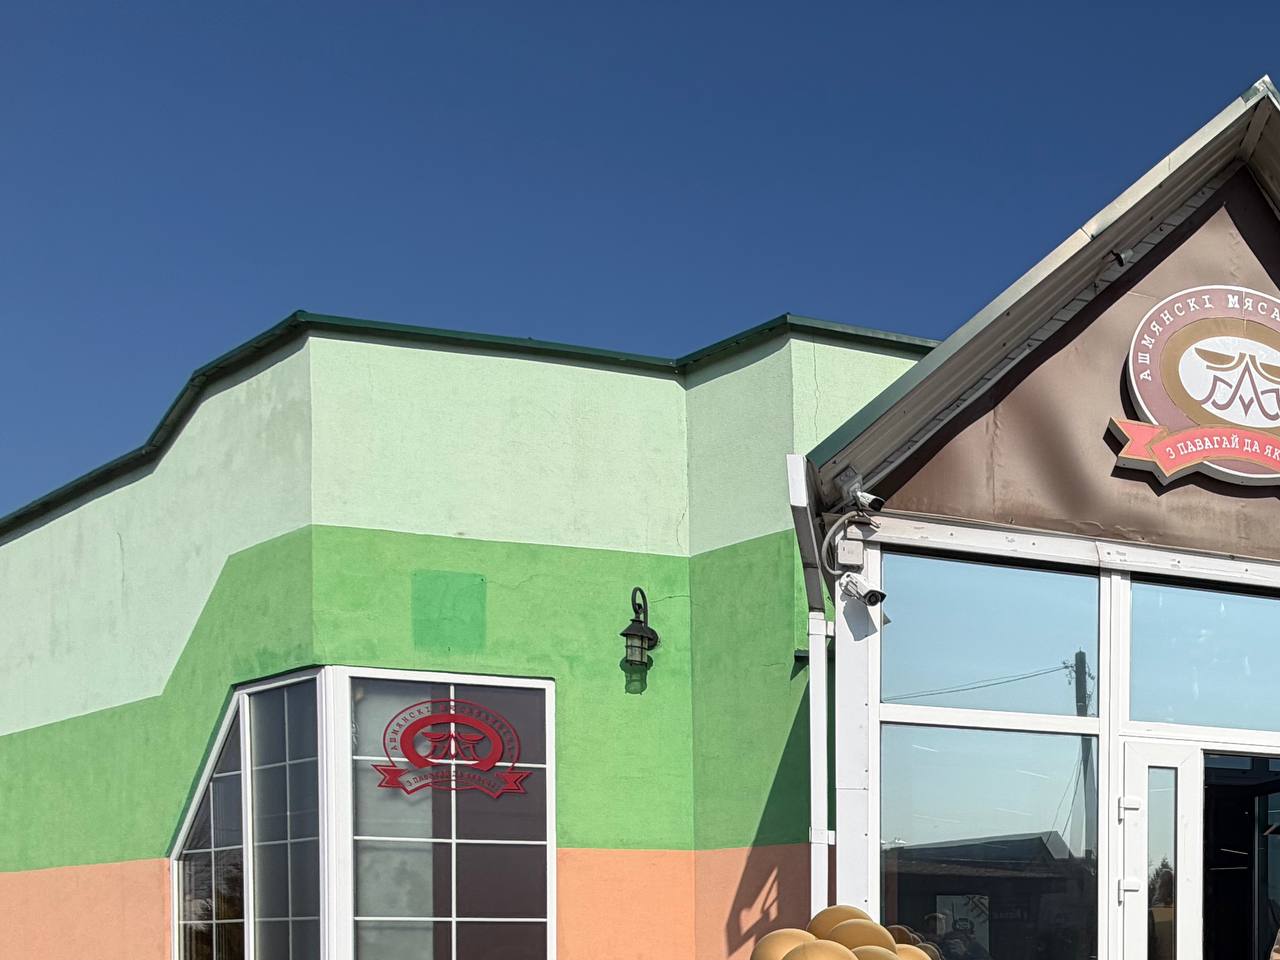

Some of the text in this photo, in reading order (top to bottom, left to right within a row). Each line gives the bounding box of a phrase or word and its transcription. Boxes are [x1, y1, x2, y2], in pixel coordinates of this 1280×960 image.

[1138, 294, 1214, 382] АШМЯНСКІ
[1166, 446, 1177, 460] З
[1180, 434, 1240, 456] ПАВАГАЙ
[1243, 438, 1261, 454] ДА
